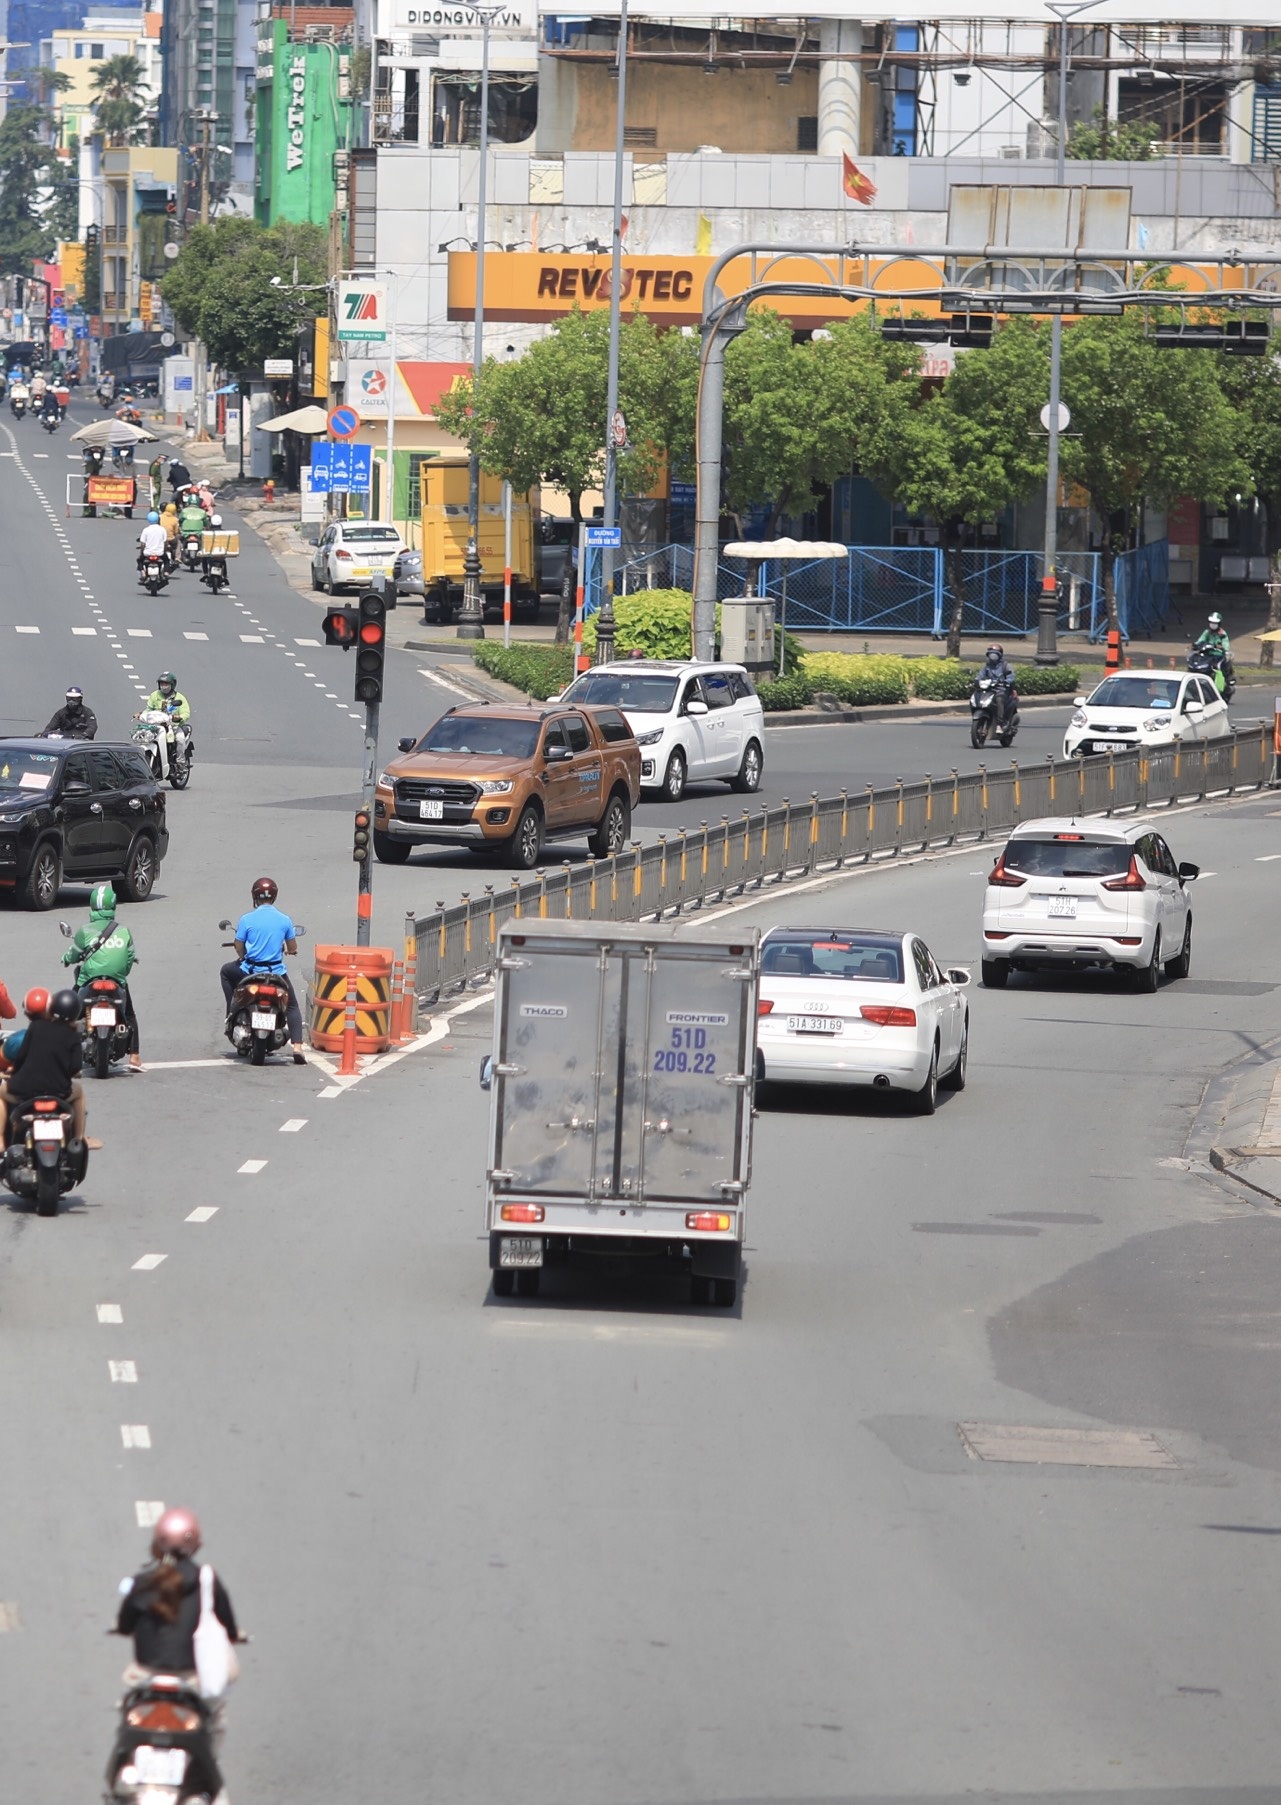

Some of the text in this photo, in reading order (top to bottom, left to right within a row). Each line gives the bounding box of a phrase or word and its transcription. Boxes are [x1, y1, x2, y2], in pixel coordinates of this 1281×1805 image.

[286, 55, 306, 172] WeTrek
[360, 398, 387, 406] CALTEX
[425, 801, 439, 810] 51D
[1056, 896, 1071, 905] 51H
[524, 1006, 565, 1017] THACO
[669, 1013, 726, 1024] FRONTIER
[789, 1017, 842, 1031] 51A 331.69
[671, 1026, 707, 1050] 51D
[653, 1050, 716, 1075] 209.22
